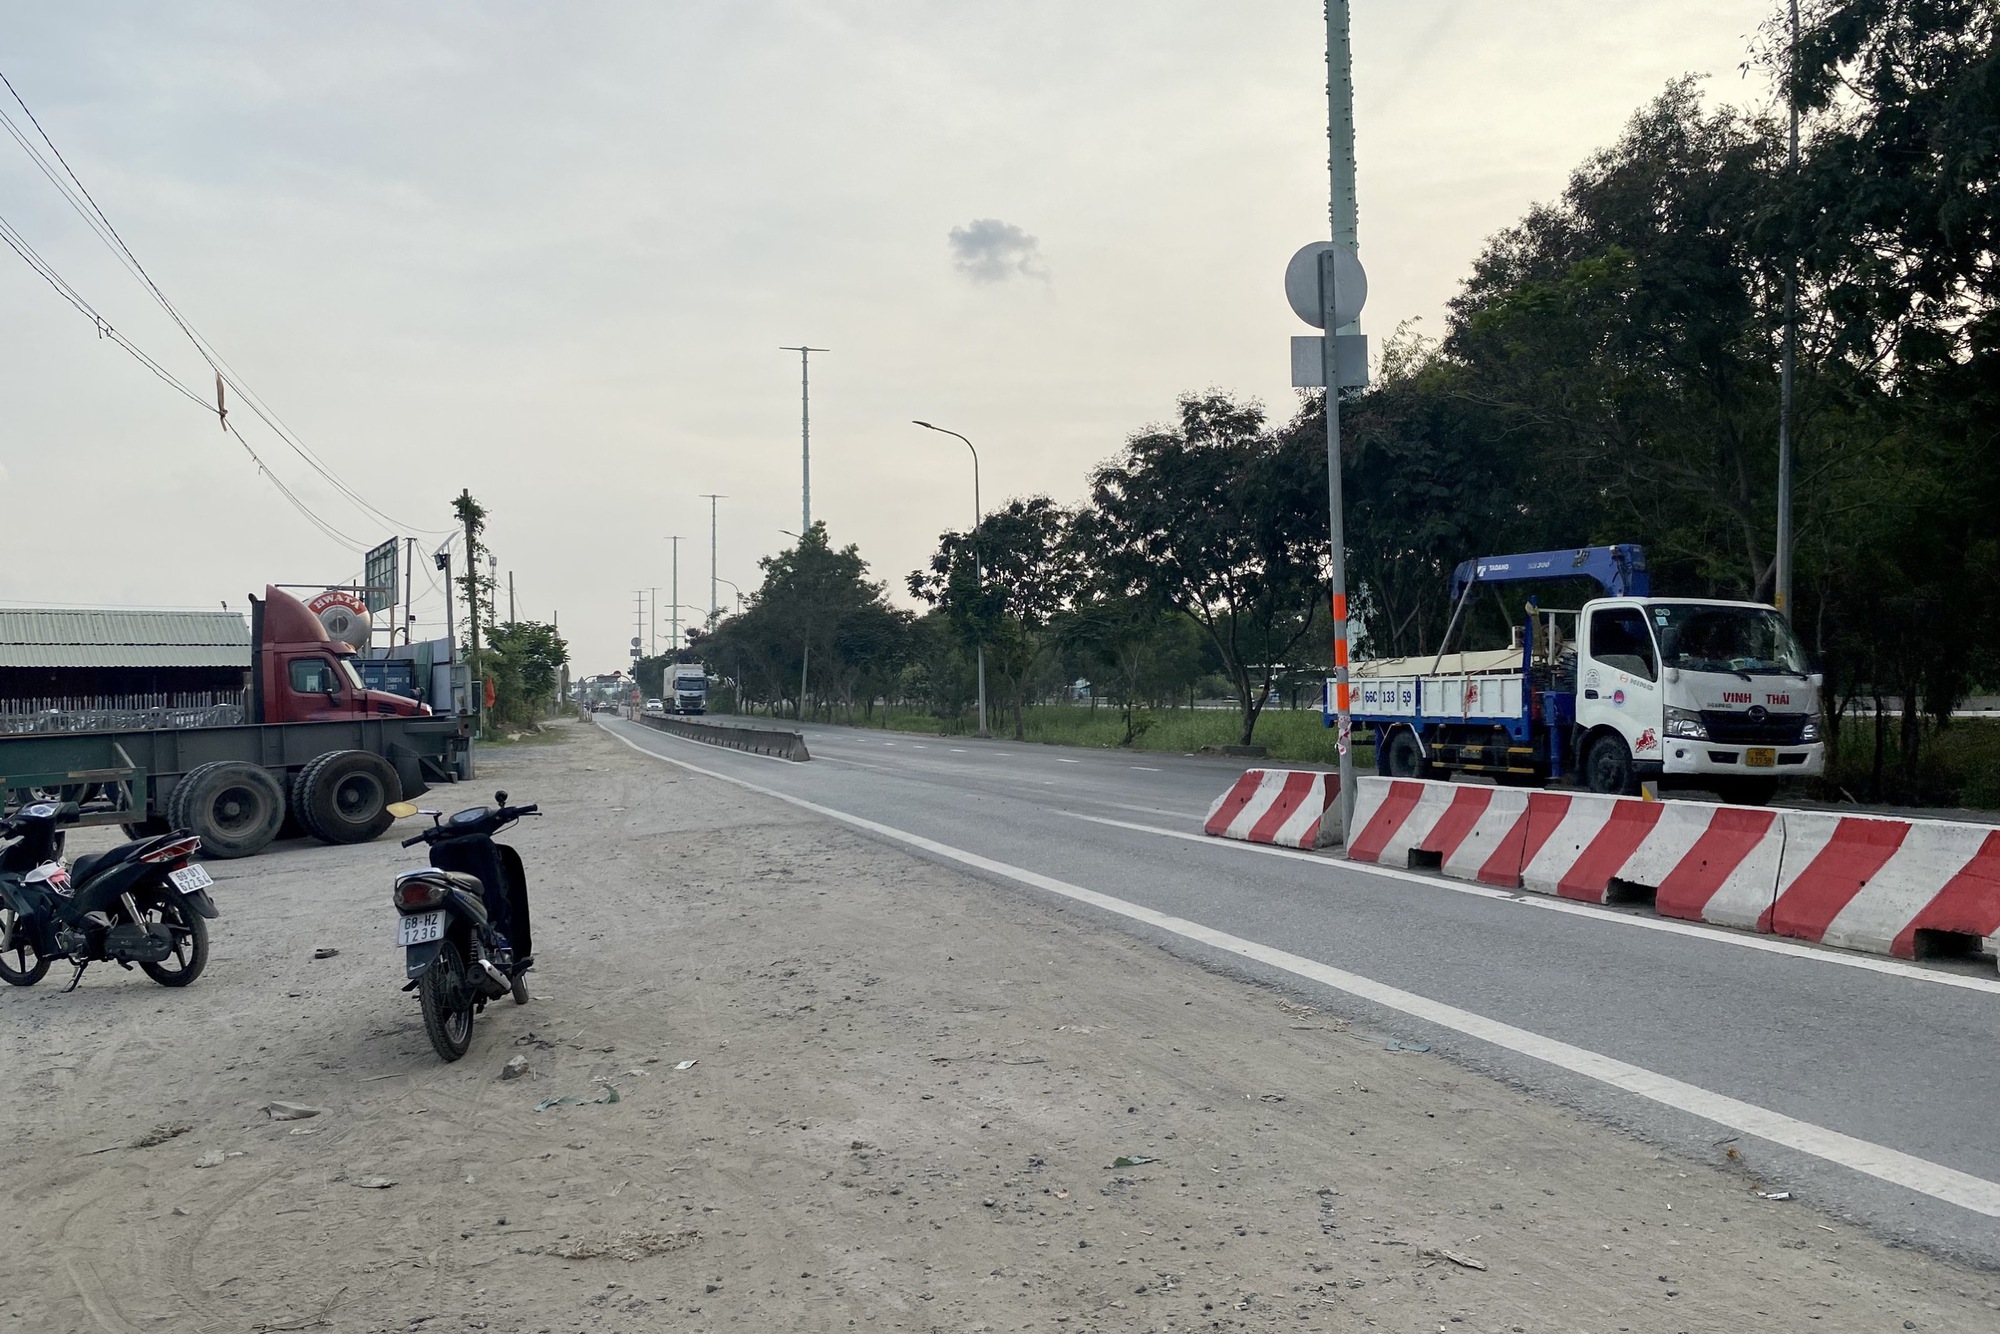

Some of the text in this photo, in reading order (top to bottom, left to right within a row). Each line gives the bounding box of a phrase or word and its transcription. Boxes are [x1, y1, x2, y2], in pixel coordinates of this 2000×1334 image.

[1488, 563, 1510, 572] TADANO
[313, 594, 360, 610] HWATA
[1365, 690, 1412, 703] 66C 133 59
[1723, 690, 1790, 705] VINH THÁI
[404, 926, 437, 944] 1236
